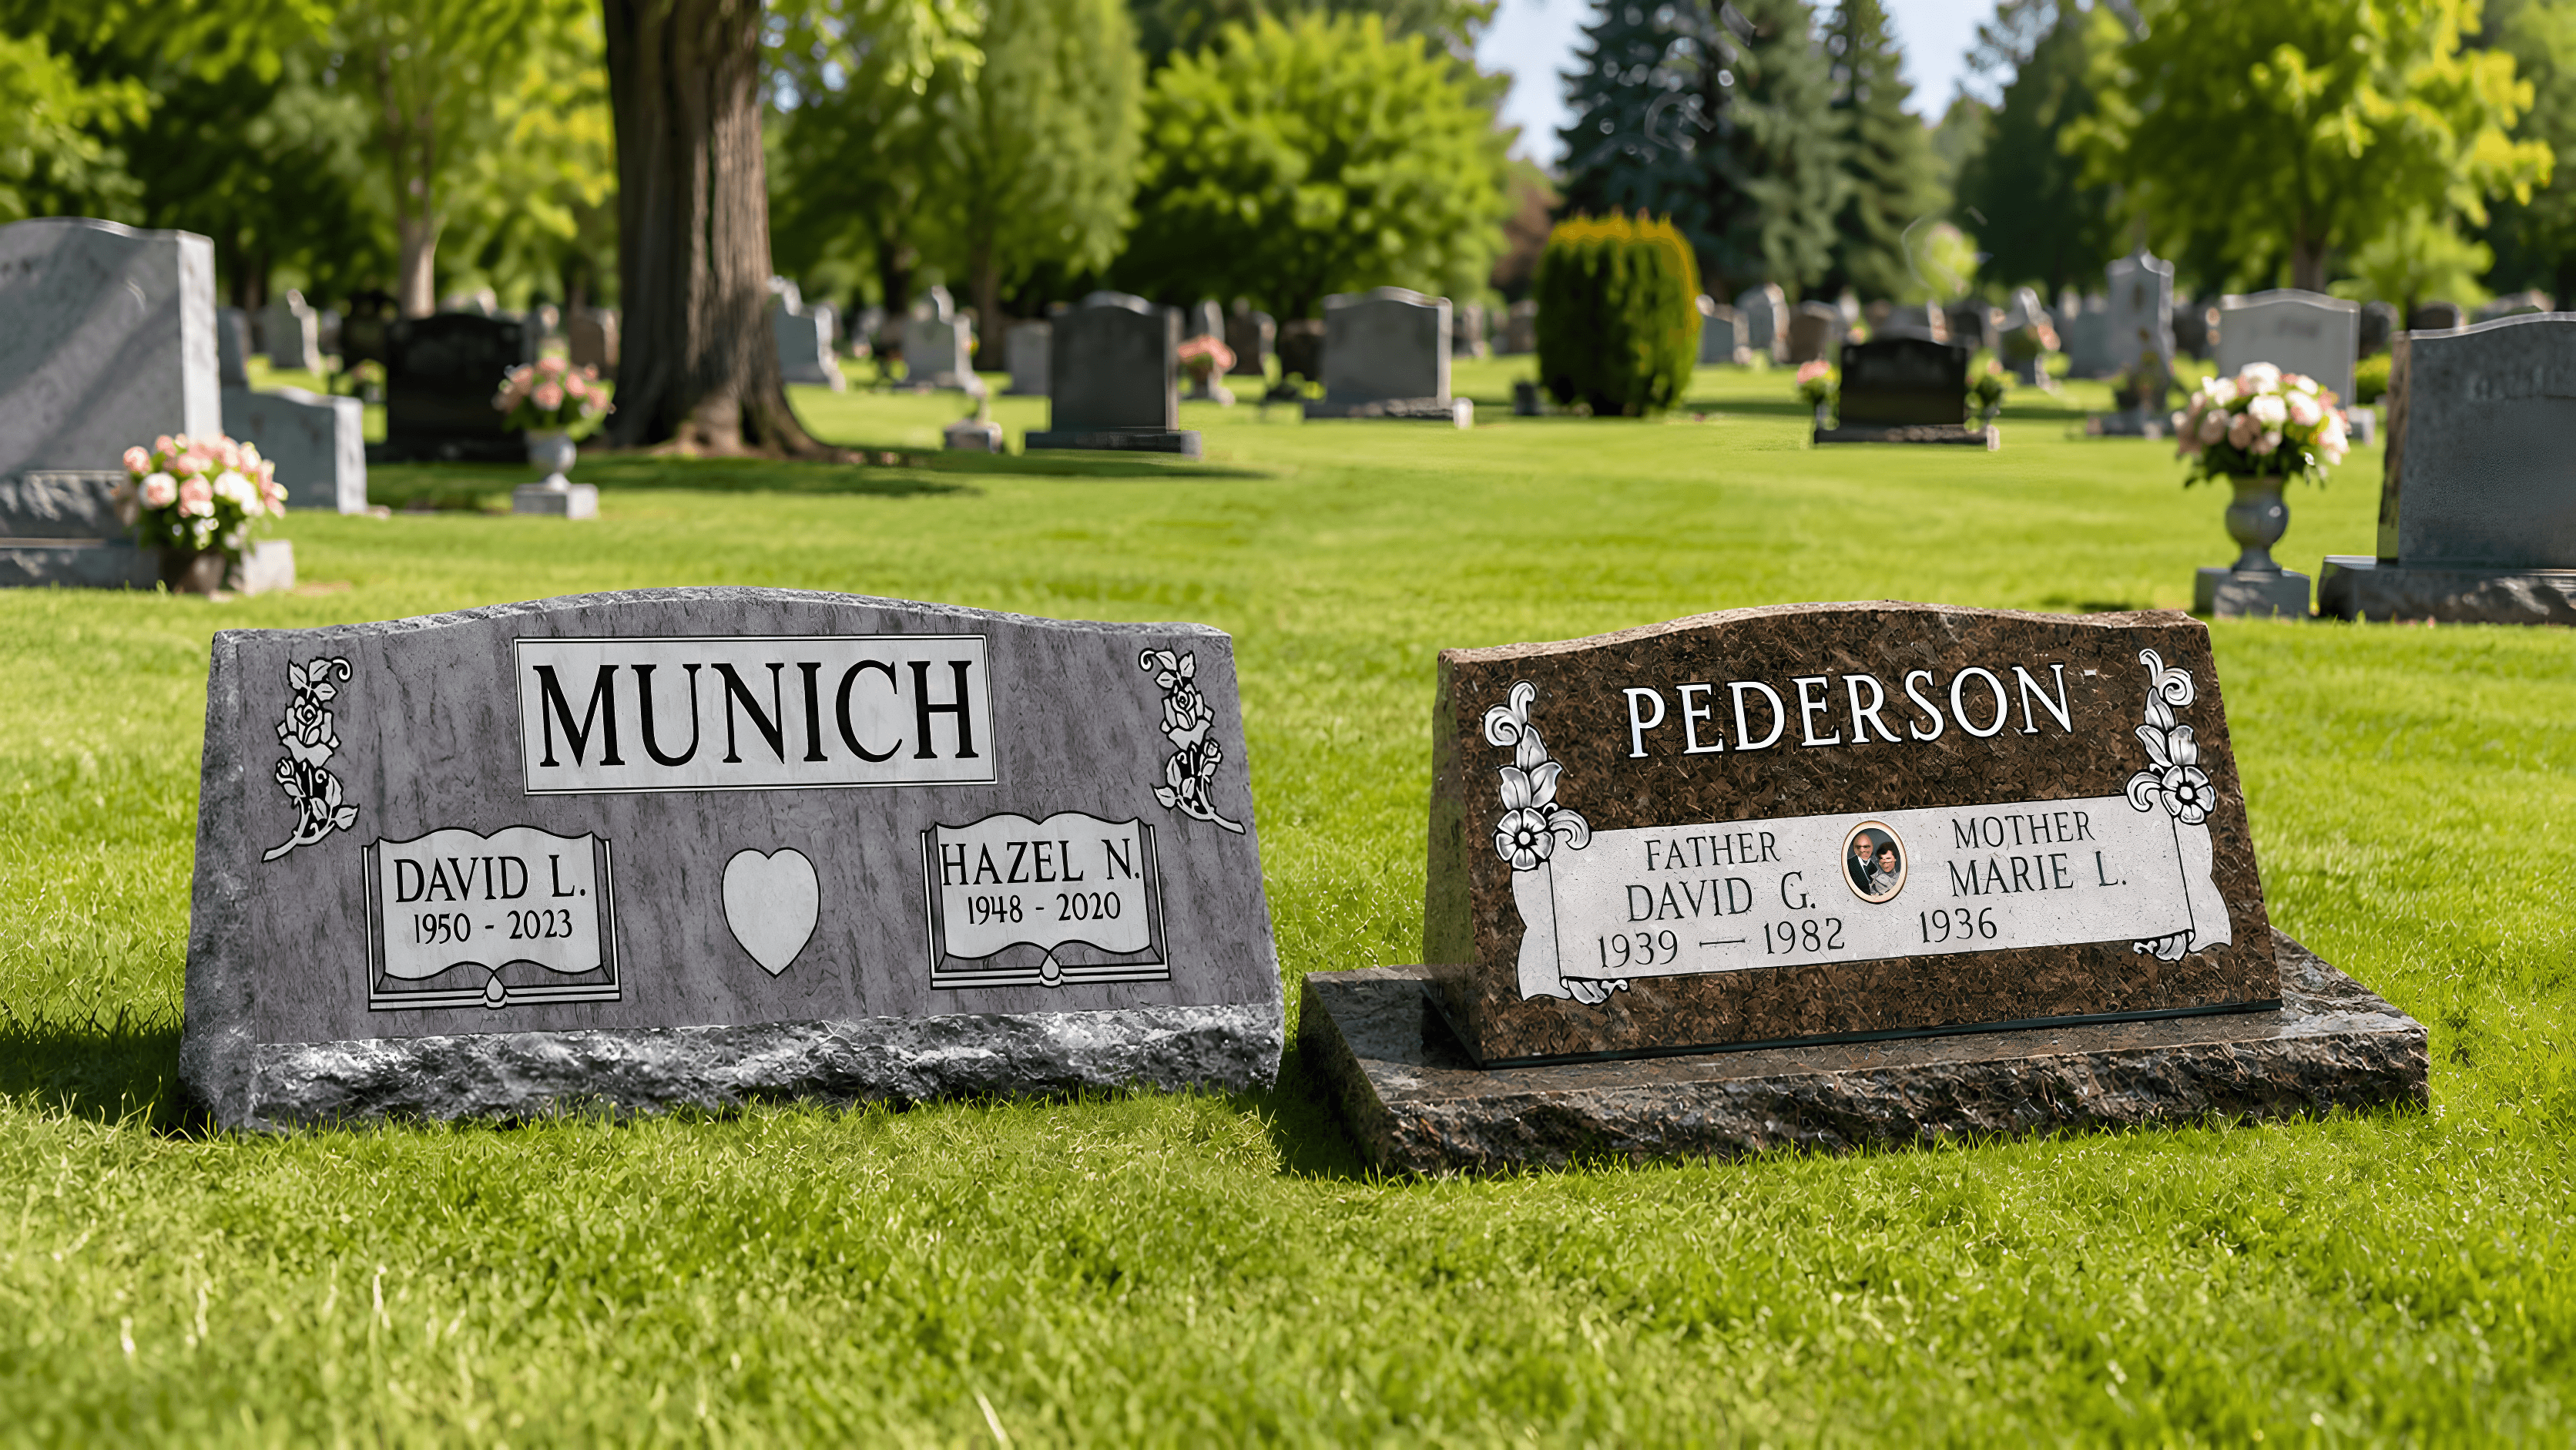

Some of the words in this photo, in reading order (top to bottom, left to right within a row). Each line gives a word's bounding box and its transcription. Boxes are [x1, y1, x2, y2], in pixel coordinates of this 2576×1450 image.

[532, 660, 979, 768] MUNICH
[1622, 663, 2072, 758] PEDERSON
[1645, 831, 1781, 871] FATHER
[1952, 811, 2095, 849] MOTHER
[394, 855, 528, 903] DAVID
[548, 854, 586, 898] L.
[940, 840, 1084, 886] HAZEL
[1101, 838, 1140, 880] N.
[1947, 853, 2073, 898] MARIE
[2095, 851, 2127, 887] L.
[968, 895, 1023, 925] 1948
[1057, 891, 1122, 921] 2020
[1625, 877, 1753, 922] DAVID
[1780, 871, 1816, 911] G.
[414, 912, 471, 945] 1950
[507, 908, 572, 940] 2023
[1598, 929, 1679, 968] 1939
[1764, 918, 1845, 955] 1982
[1919, 907, 1997, 943] 1936
